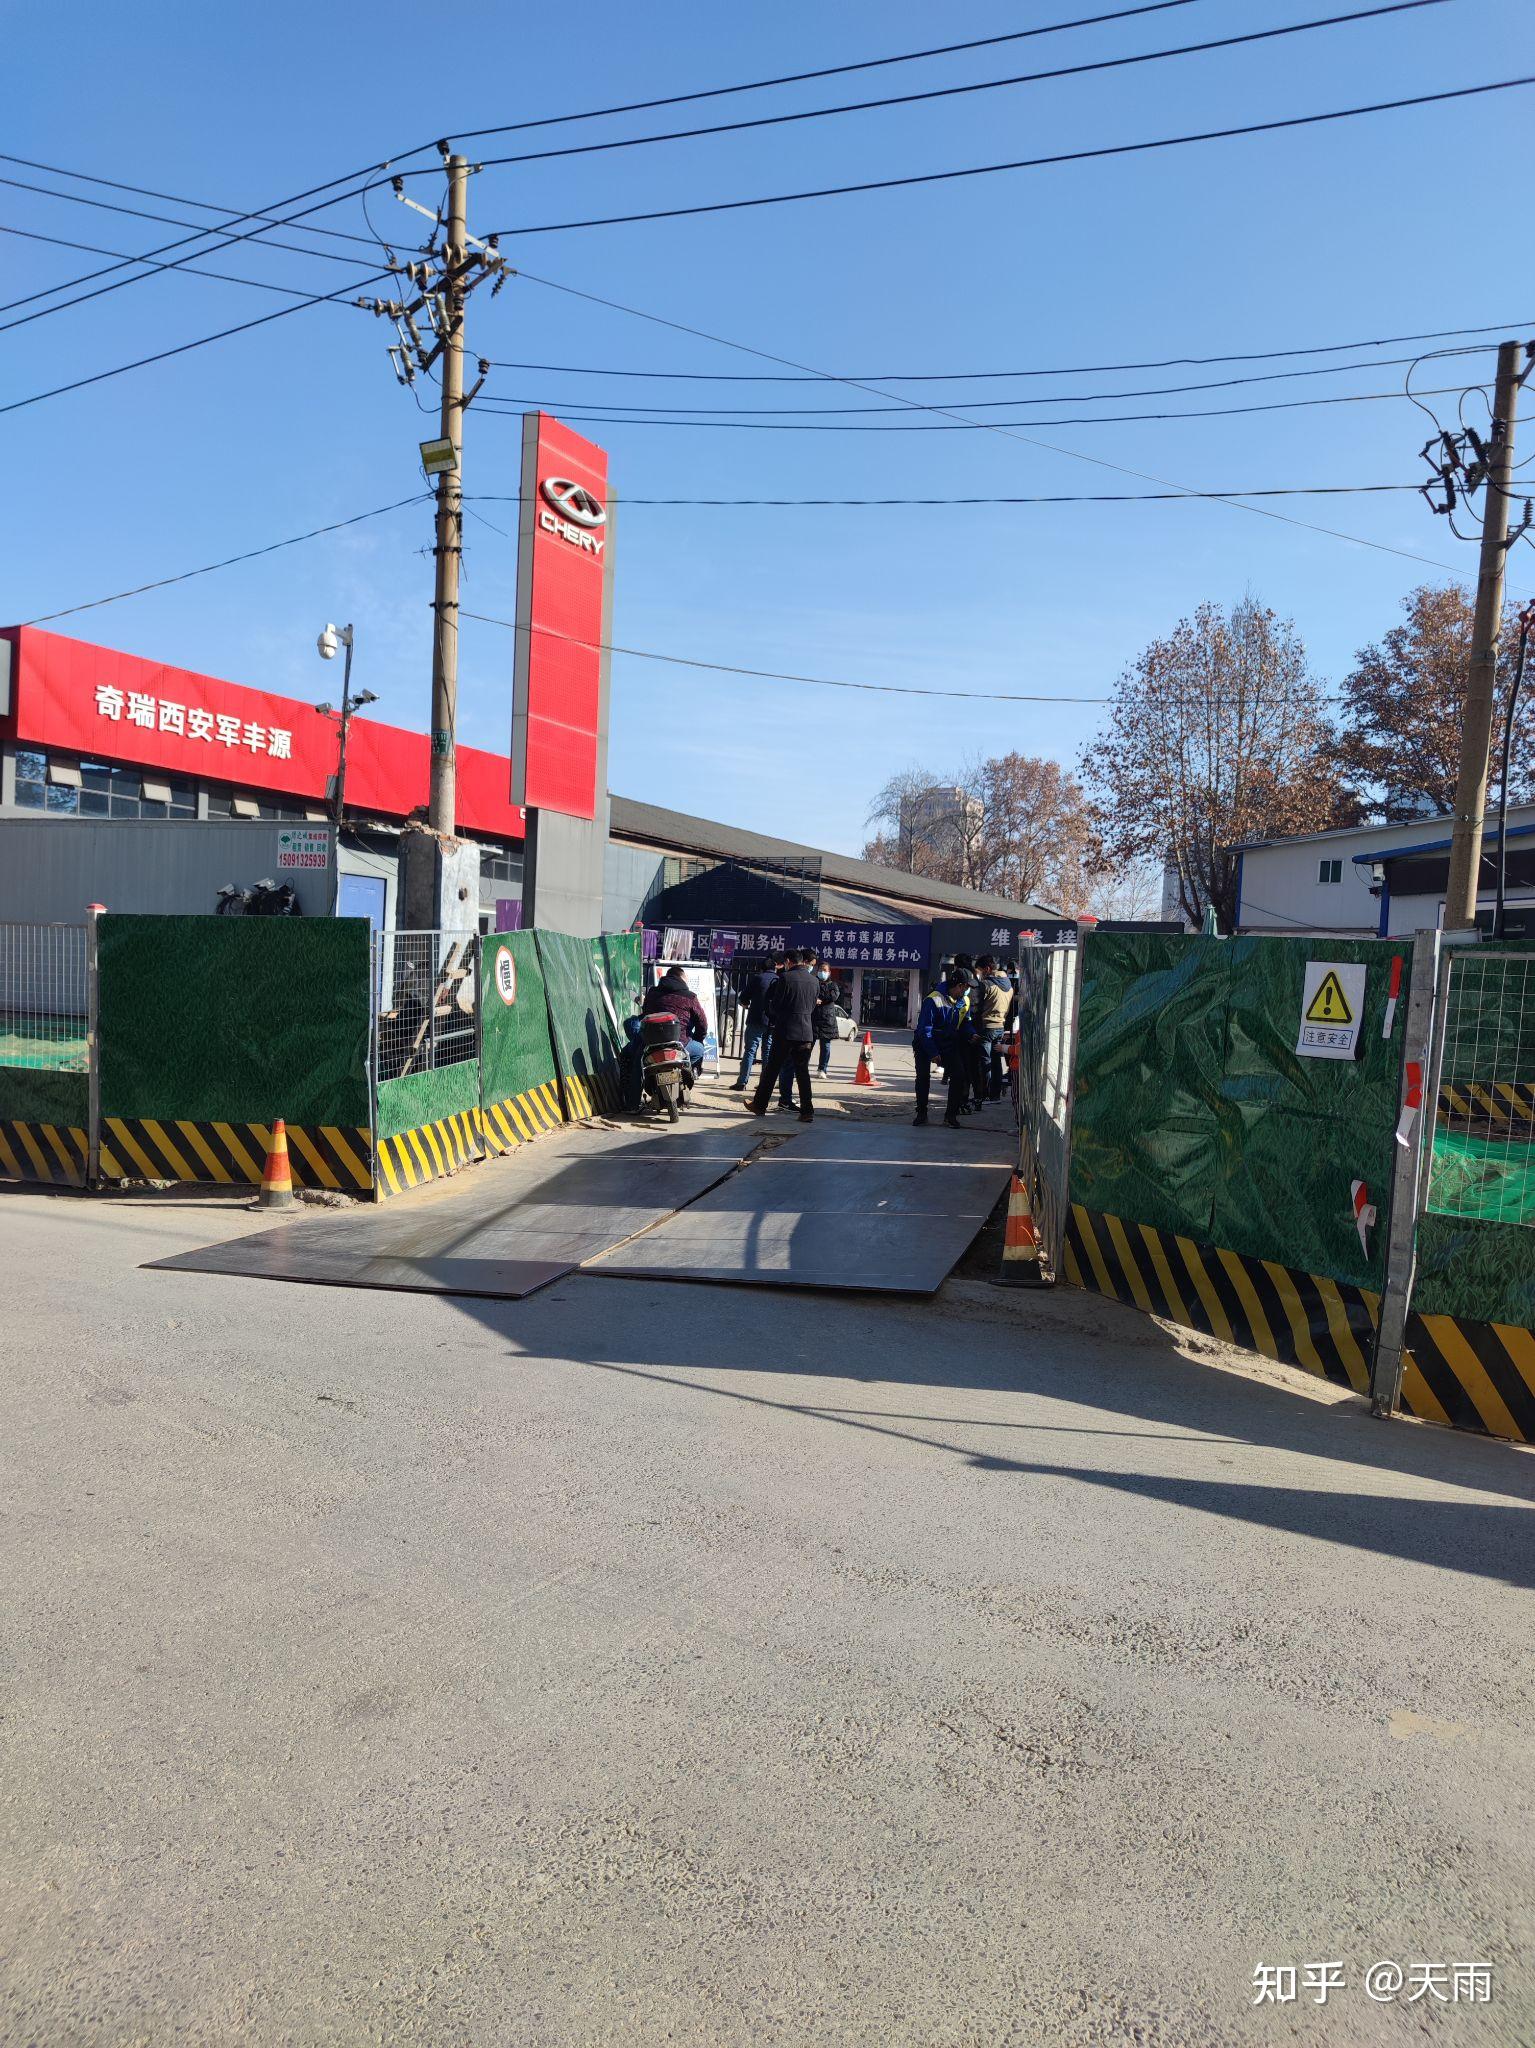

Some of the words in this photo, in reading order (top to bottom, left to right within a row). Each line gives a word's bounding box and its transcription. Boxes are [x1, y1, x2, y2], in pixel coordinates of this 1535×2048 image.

[540, 511, 604, 555] CHERY
[95, 684, 292, 760] 奇瑞西安军丰源
[821, 929, 896, 944] 西安市莲湖区
[796, 945, 921, 962] 快赔综合服务中心
[1305, 1030, 1349, 1046] 注意安全
